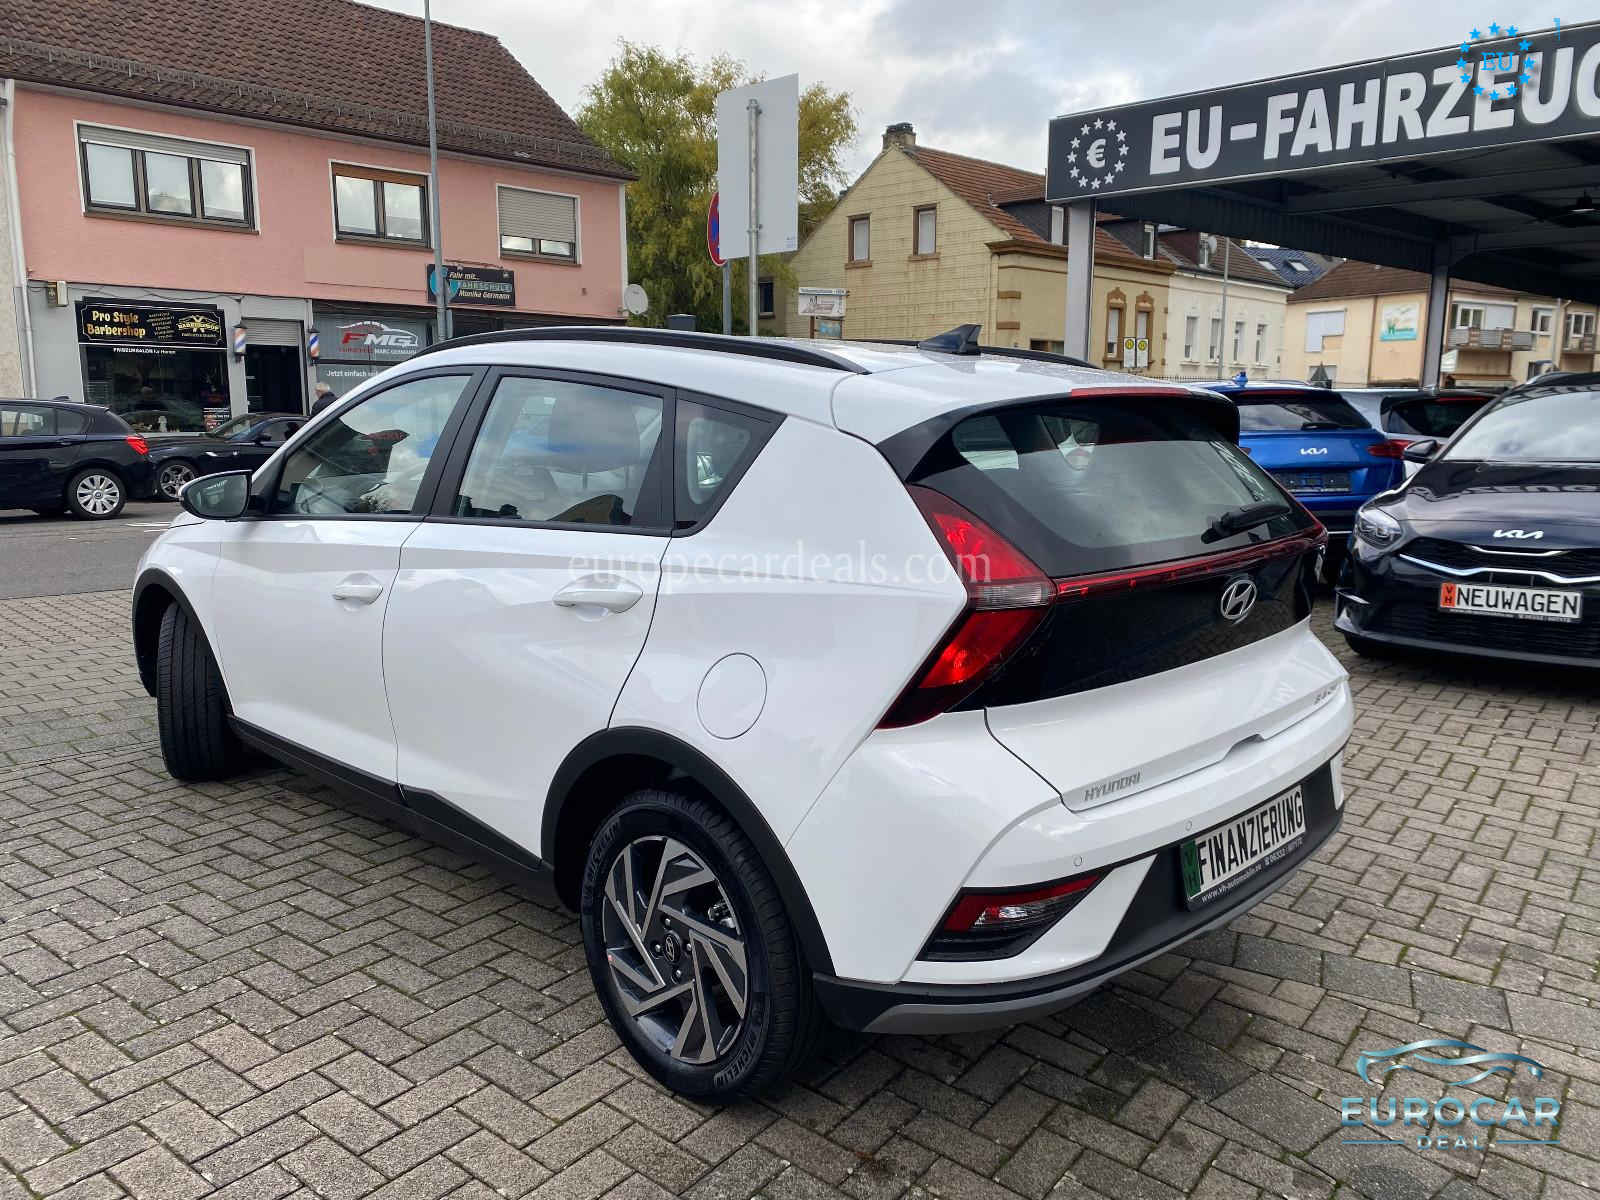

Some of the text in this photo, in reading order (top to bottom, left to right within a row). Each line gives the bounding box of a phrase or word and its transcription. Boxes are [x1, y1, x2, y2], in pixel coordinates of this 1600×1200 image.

[457, 281, 510, 290] FAHRSCHULE
[458, 290, 511, 300] Monika Germann
[92, 310, 111, 322] Pro
[112, 311, 139, 325] Style
[86, 323, 146, 339] Barbershop
[326, 369, 343, 377] Jetzt
[343, 369, 367, 377] einfach
[1456, 587, 1579, 615] NEUWAGEN
[1084, 771, 1141, 802] HYUNDAI
[1197, 791, 1303, 886] FINANZIERUNG
